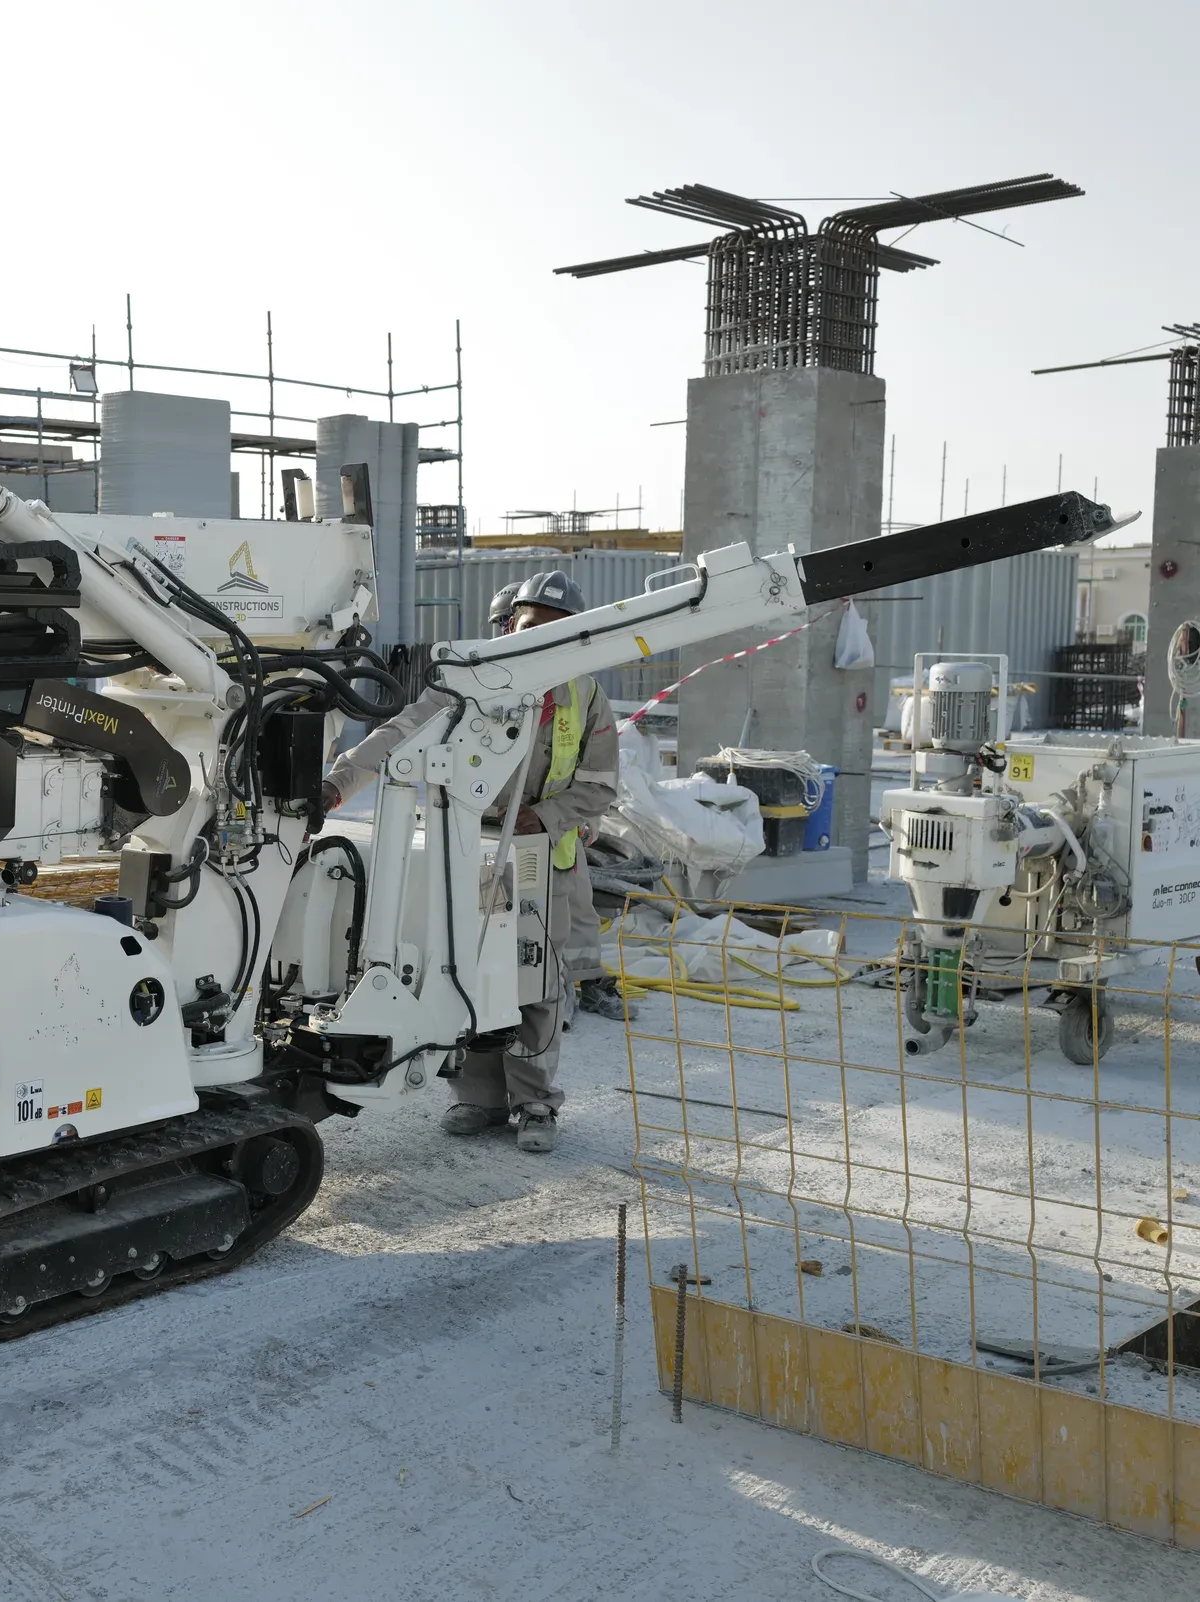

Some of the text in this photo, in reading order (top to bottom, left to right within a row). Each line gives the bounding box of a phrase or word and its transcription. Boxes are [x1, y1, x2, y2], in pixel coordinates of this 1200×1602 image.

[235, 613, 246, 622] 3D
[36, 694, 119, 735] MaxiPrinter
[1012, 766, 1028, 779] 91
[475, 784, 483, 794] 4
[17, 1099, 34, 1122] 101
[35, 1107, 43, 1119] dB
